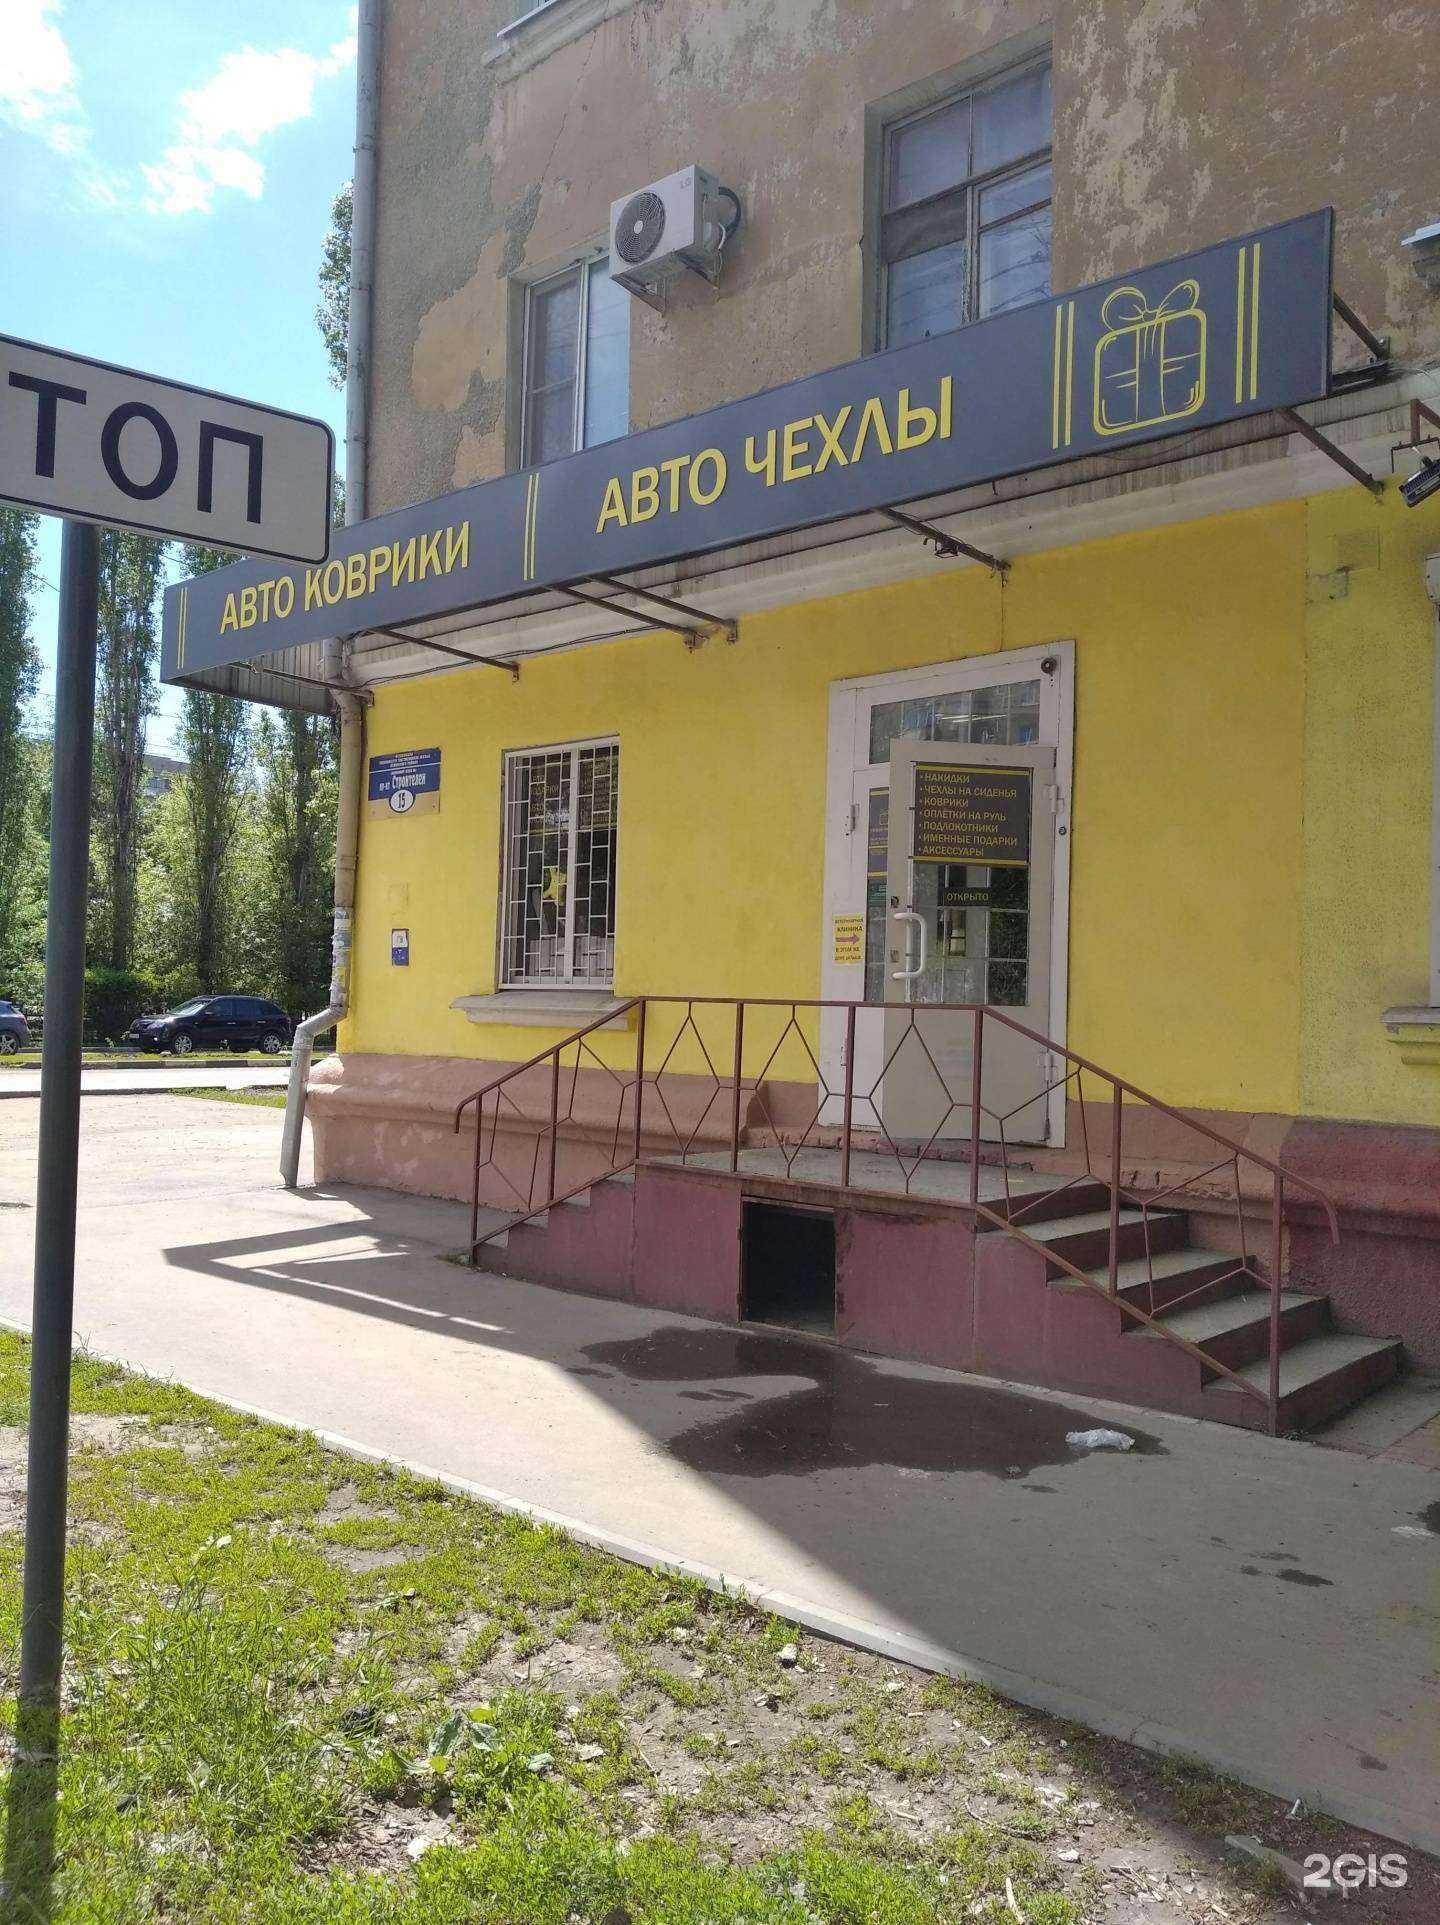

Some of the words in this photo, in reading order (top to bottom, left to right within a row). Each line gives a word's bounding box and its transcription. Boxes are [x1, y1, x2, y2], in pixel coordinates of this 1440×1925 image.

[596, 448, 727, 533] АВТО
[744, 376, 952, 486] ЧЕХЛЫ
[220, 576, 295, 634] АВТО
[304, 521, 470, 612] КОВРИКИ
[925, 773, 970, 784] НАКИДКИ
[924, 785, 957, 795] ЧЕХЛЫ
[959, 787, 972, 796] НА
[974, 787, 1017, 798] СИДЕНЬЯ
[397, 792, 406, 808] 15
[924, 797, 969, 807] КОВРИКИ
[924, 809, 966, 819] ОПЛЕТКИ
[968, 811, 982, 820] НА
[983, 811, 1006, 821] РУЛЬ
[923, 821, 998, 833] ПОДЛОКОТНИКИ
[923, 833, 971, 844] ИМЕННЫЕ
[973, 836, 1018, 846] ПОДАРКИ
[922, 846, 984, 856] АКСЕССУАРЫ
[946, 892, 989, 902] ОТКРЫТО
